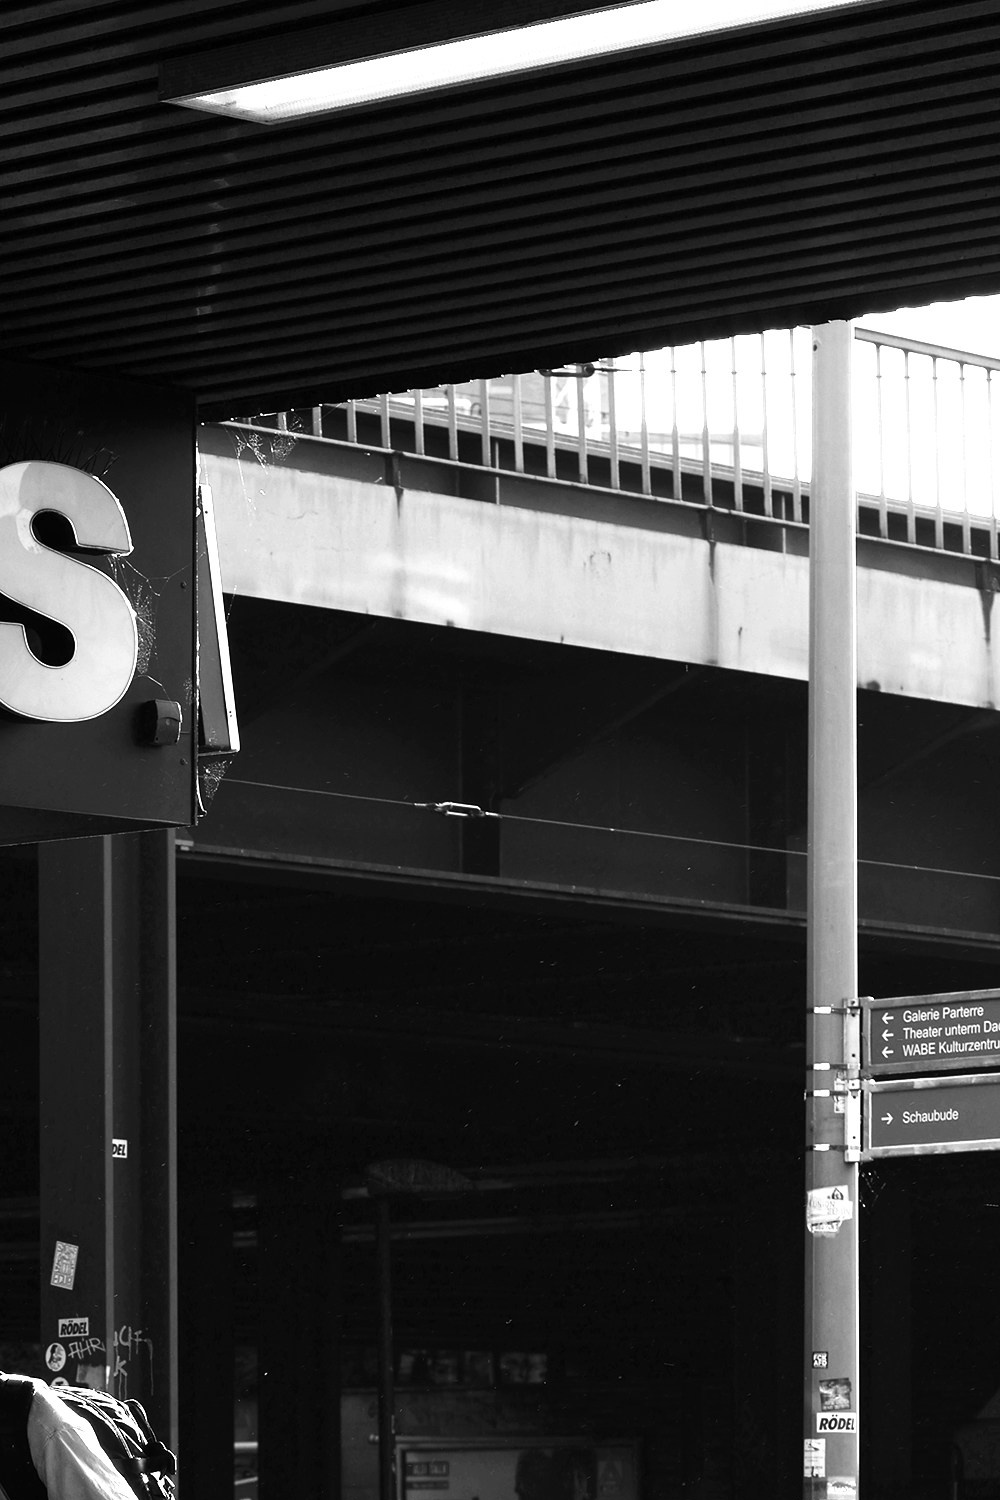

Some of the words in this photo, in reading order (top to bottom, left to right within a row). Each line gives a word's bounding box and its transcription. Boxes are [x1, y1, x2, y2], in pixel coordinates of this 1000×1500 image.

[902, 1008, 940, 1022] Galerie
[942, 1006, 984, 1019] Parterre
[902, 1026, 943, 1039] Theater
[944, 1024, 981, 1036] unterm
[902, 1042, 936, 1057] WABE
[902, 1109, 959, 1124] Schaubude
[60, 1320, 88, 1336] RÖDEL
[819, 1414, 855, 1430] RÖDEL
